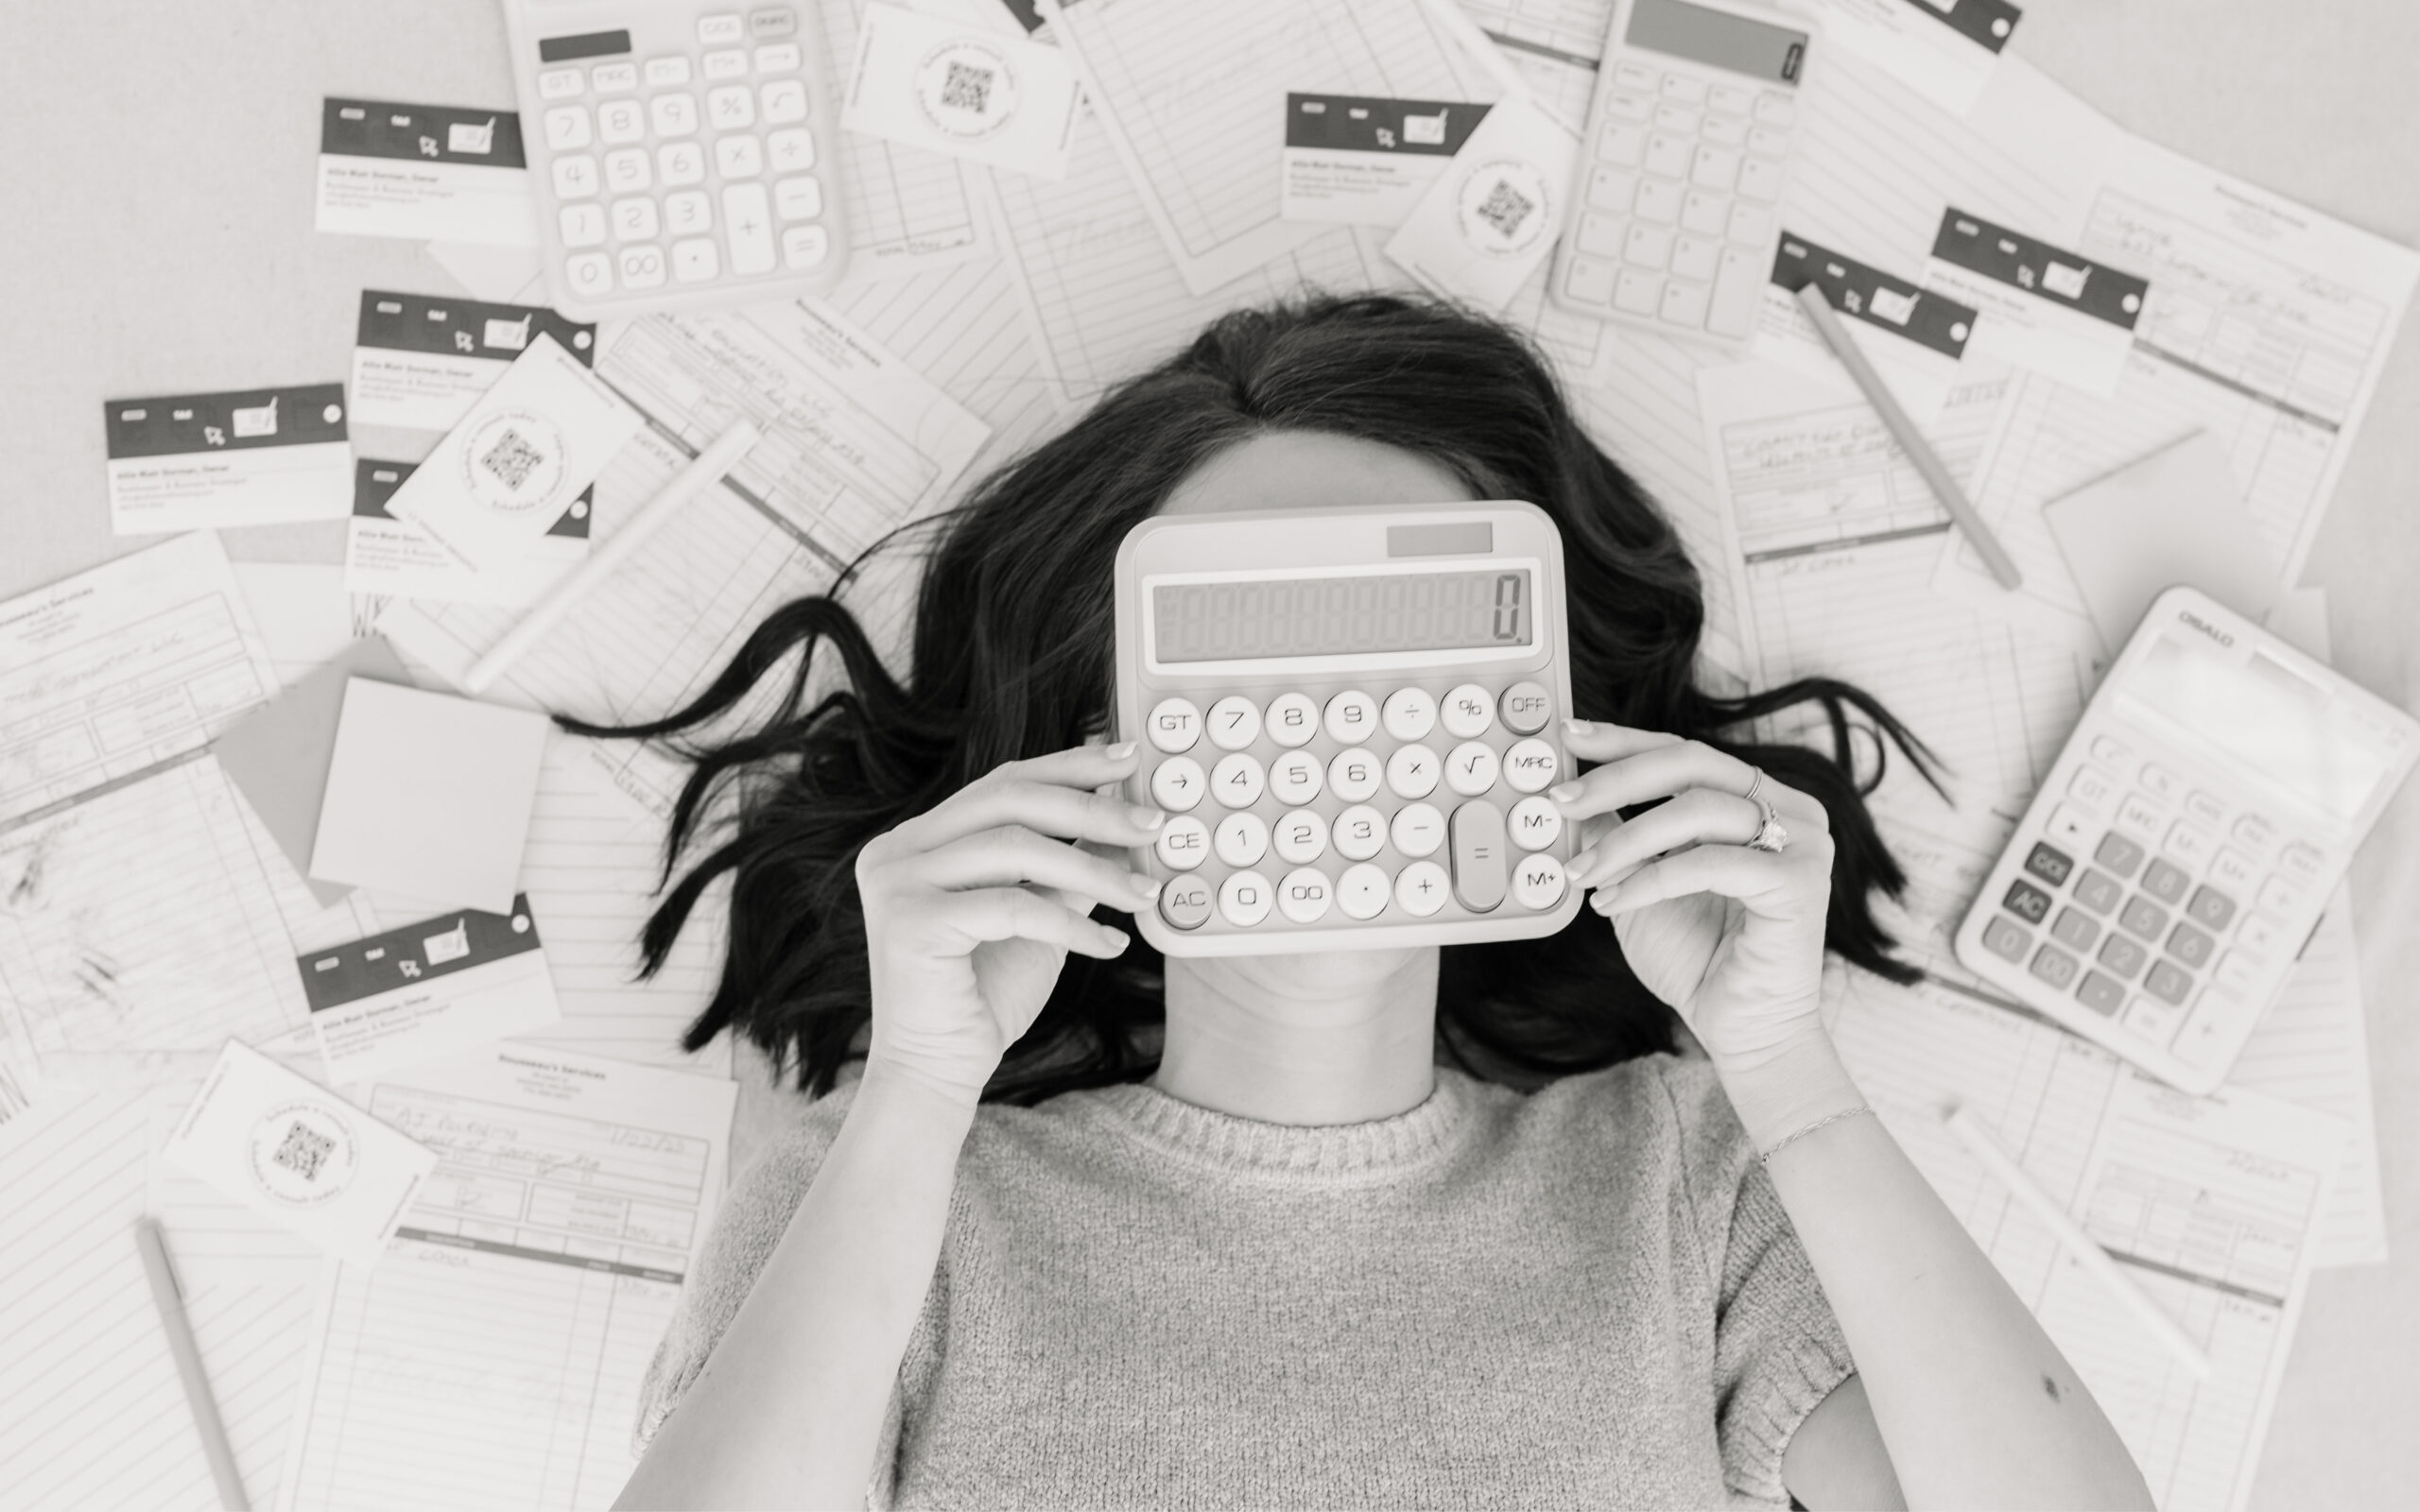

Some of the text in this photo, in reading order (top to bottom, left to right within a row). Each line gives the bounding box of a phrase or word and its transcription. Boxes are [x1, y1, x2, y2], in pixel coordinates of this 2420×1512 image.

[612, 110, 631, 130] 8
[664, 102, 681, 122] 9
[560, 115, 575, 137] 7
[617, 159, 638, 180] 5
[672, 153, 690, 173] 6
[565, 166, 582, 183] 4
[626, 207, 643, 229] 2
[683, 201, 695, 222] 3
[579, 214, 585, 234] 1
[579, 263, 597, 284] 0
[1512, 697, 1545, 713] OFF
[1160, 715, 1191, 730] GT
[1226, 713, 1244, 729] 7
[1285, 709, 1303, 726] 8
[1344, 706, 1362, 723] 9
[1516, 757, 1552, 768] MRC
[1231, 770, 1247, 786] 4
[1289, 766, 1307, 783] 5
[1349, 765, 1366, 782] 6
[1354, 821, 1371, 839] 3
[1525, 816, 1551, 827] M-
[1169, 833, 1200, 850] CE
[1237, 830, 1246, 846] 1
[1294, 826, 1311, 844] 2
[1528, 872, 1554, 885] M+
[1173, 891, 1205, 907] AC
[1238, 888, 1256, 905] 0
[1292, 886, 1322, 900] 00
[2013, 889, 2045, 919] AC
